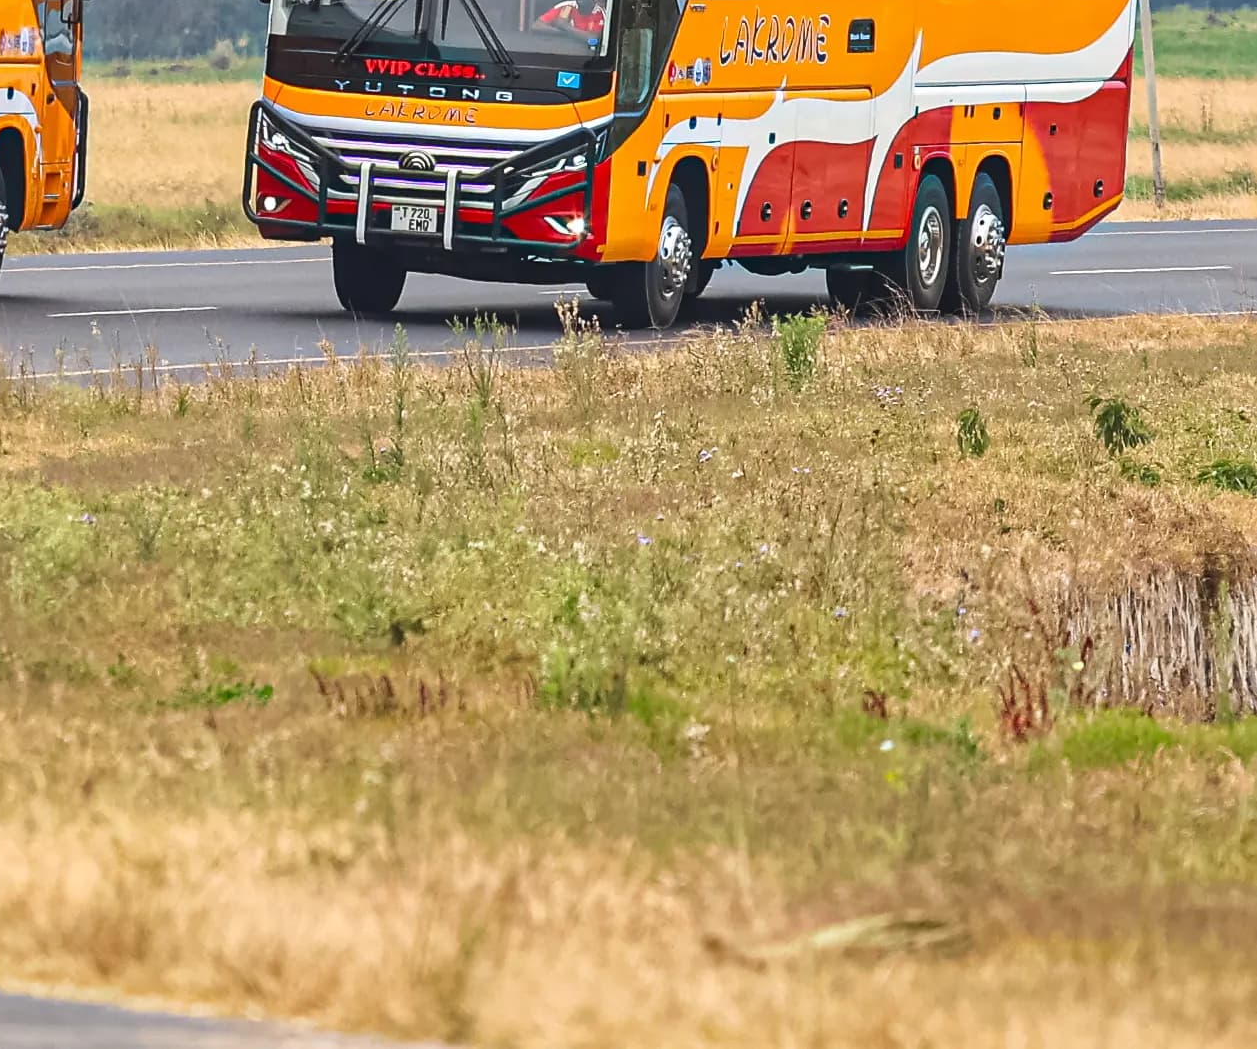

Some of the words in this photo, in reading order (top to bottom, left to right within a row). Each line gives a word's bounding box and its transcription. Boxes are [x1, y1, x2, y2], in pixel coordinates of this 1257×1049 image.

[719, 6, 831, 66] LAKROME
[364, 59, 411, 76] VVIP
[334, 79, 513, 101] YUTONG
[364, 99, 479, 124] LAKROME
[410, 207, 430, 220] 720
